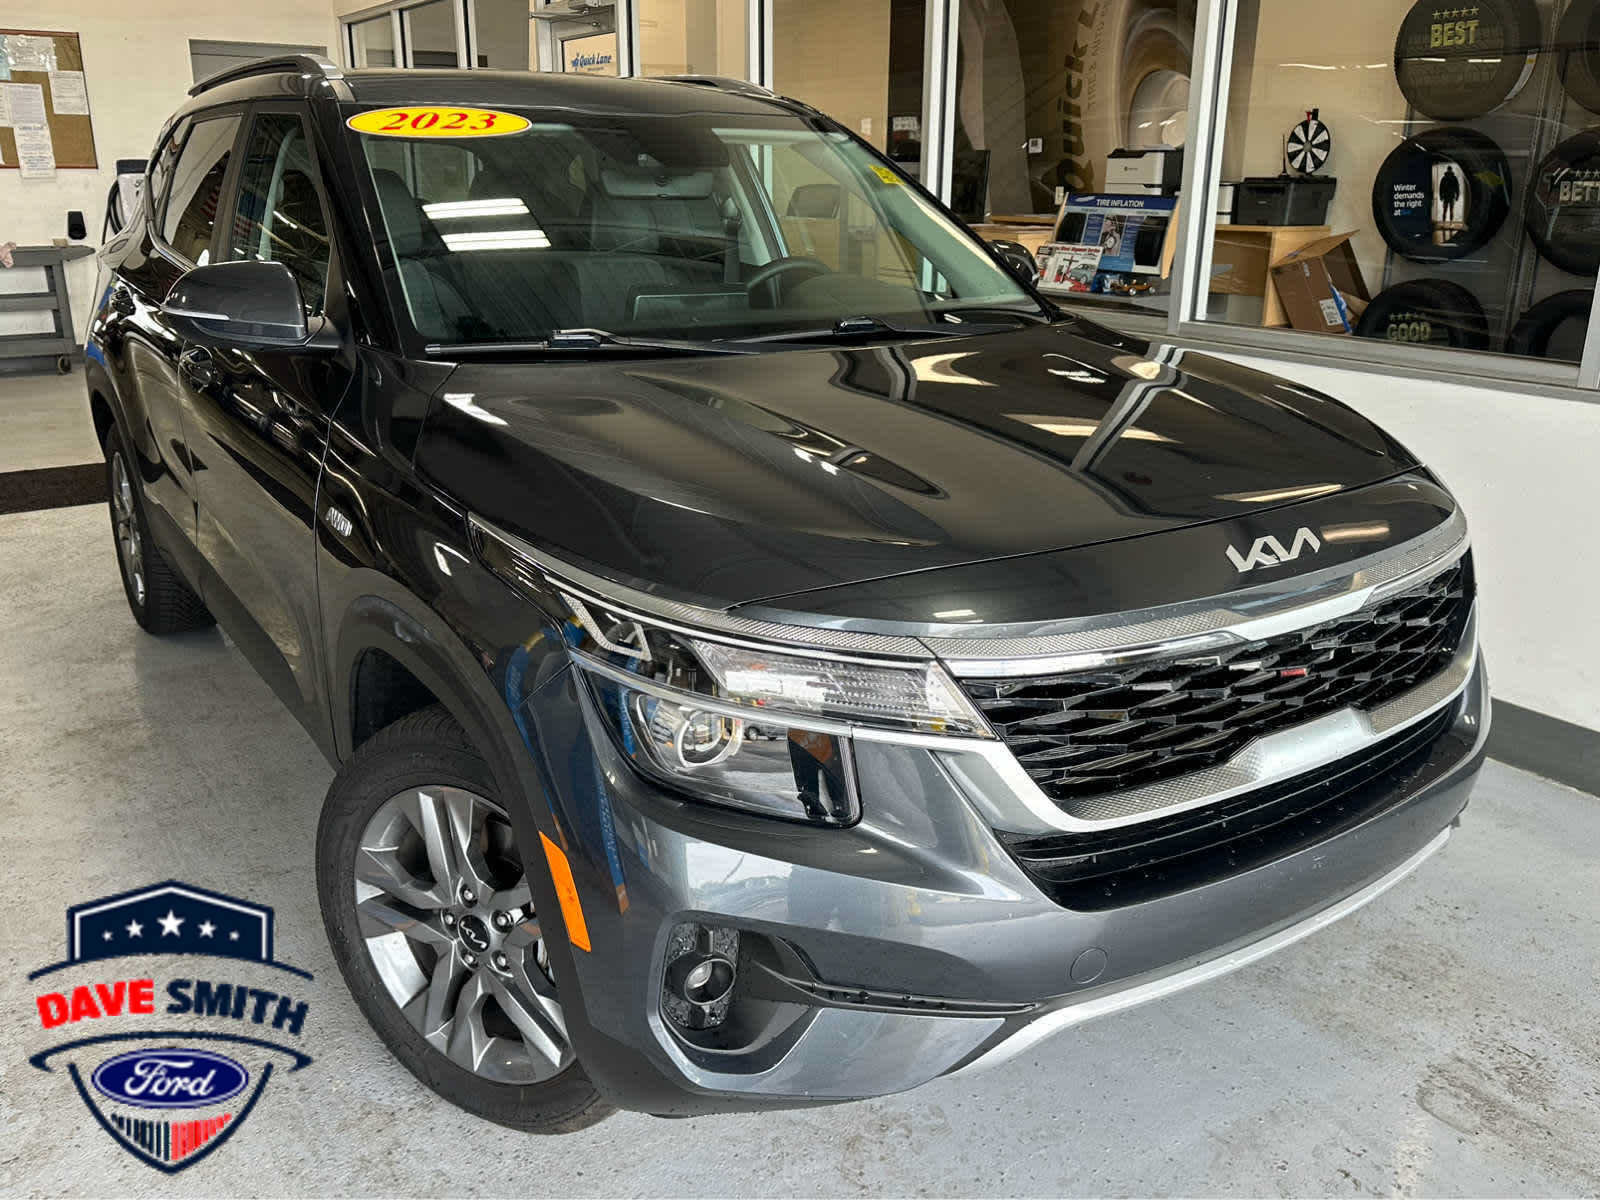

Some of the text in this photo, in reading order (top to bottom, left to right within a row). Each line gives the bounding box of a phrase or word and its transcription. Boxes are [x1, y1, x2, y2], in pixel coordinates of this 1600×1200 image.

[1430, 20, 1479, 48] BEST
[580, 53, 612, 68] Quick Lane
[1394, 192, 1424, 200] demands
[1096, 199, 1144, 208] TIRE INFLATION
[1394, 200, 1422, 208] the right
[1387, 322, 1431, 341] GOOD
